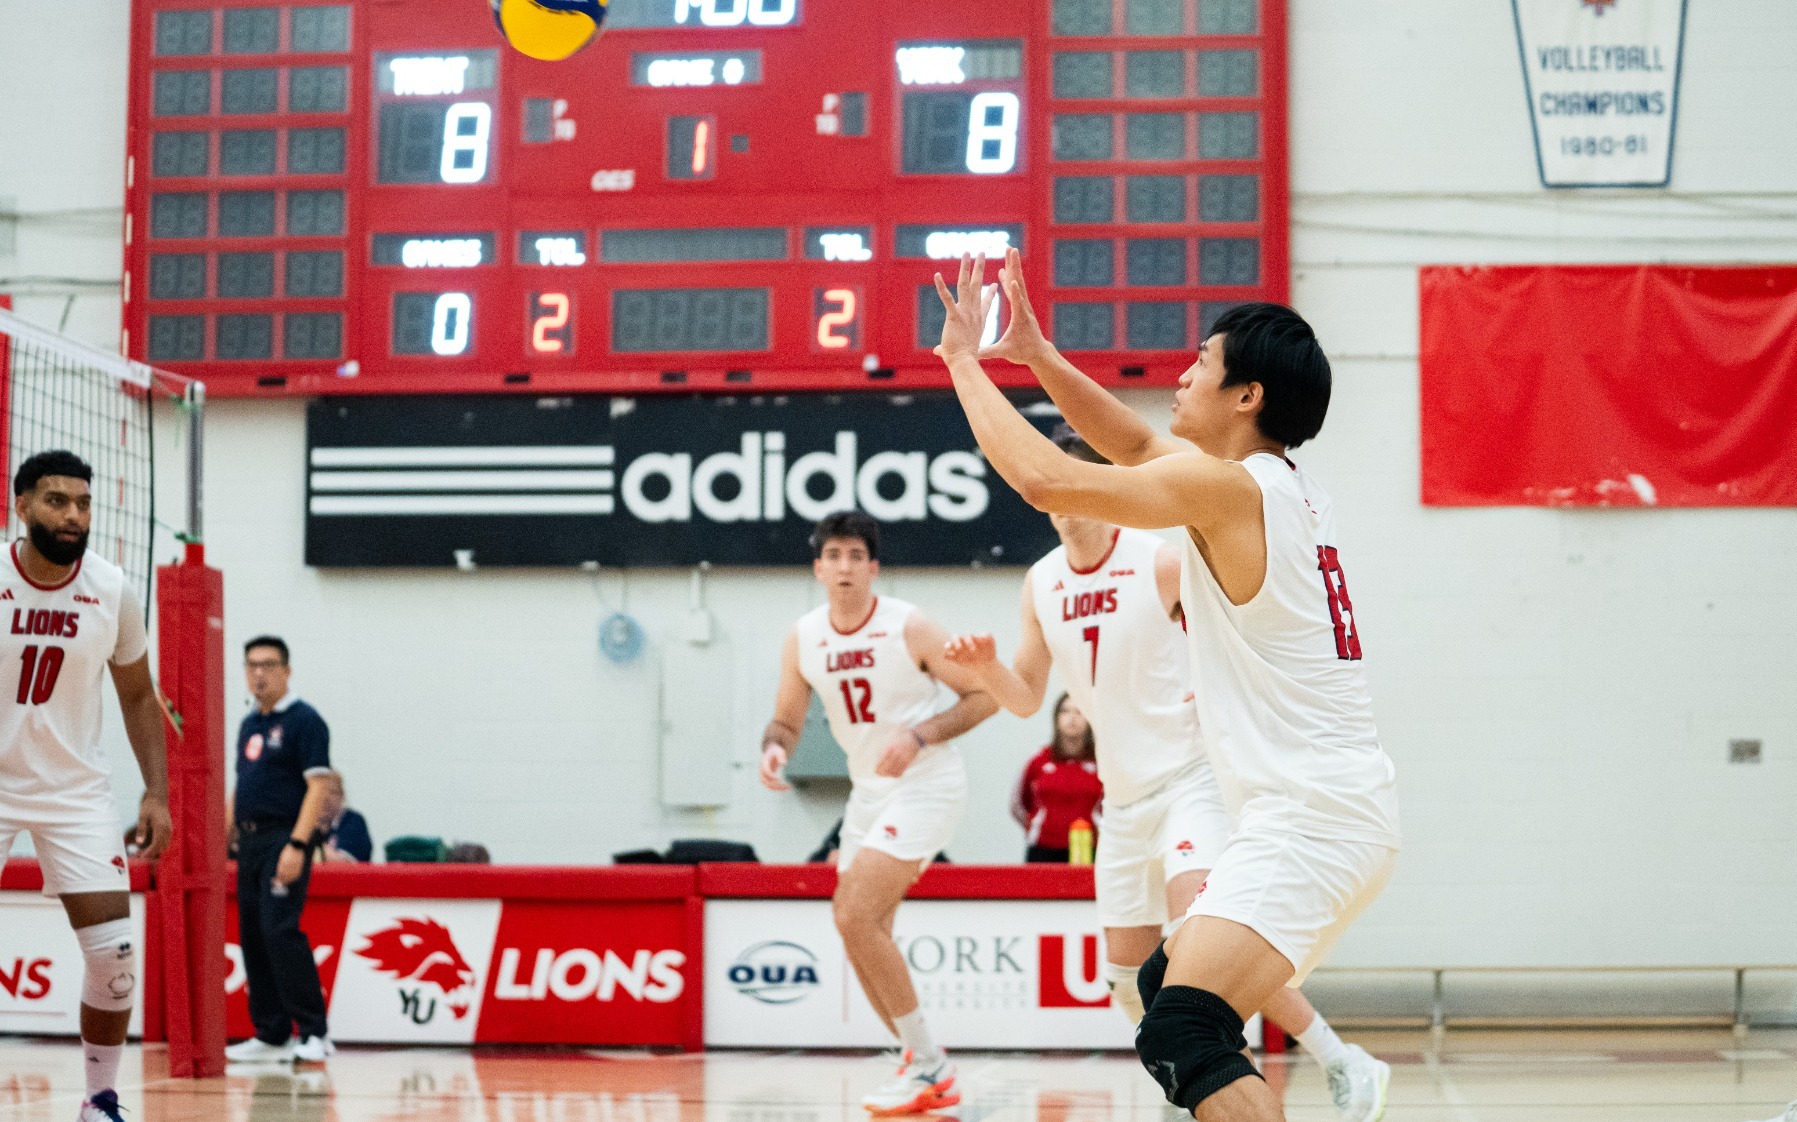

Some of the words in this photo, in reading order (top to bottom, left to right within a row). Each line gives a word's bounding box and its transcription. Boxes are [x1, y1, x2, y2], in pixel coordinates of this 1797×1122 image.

[1537, 44, 1664, 72] VOLLEYBALL
[1539, 91, 1666, 116] CHAMPIONS
[440, 102, 491, 183] 8
[692, 120, 709, 174] 1
[966, 92, 1019, 174] 8
[431, 292, 471, 355] 0
[532, 293, 569, 353] 2
[817, 289, 856, 349] 2
[620, 431, 988, 522] adidas
[11, 608, 80, 638] LIONS
[1062, 587, 1118, 622] LIONS
[1316, 544, 1362, 661] 13
[16, 644, 65, 706] 10
[826, 648, 875, 674] LIONS
[1082, 625, 1099, 687] 7
[839, 677, 876, 725] 12
[494, 948, 687, 1003] LIONS
[728, 963, 819, 986] OUA
[896, 934, 1024, 974] ORK
[398, 988, 436, 1025] YU
